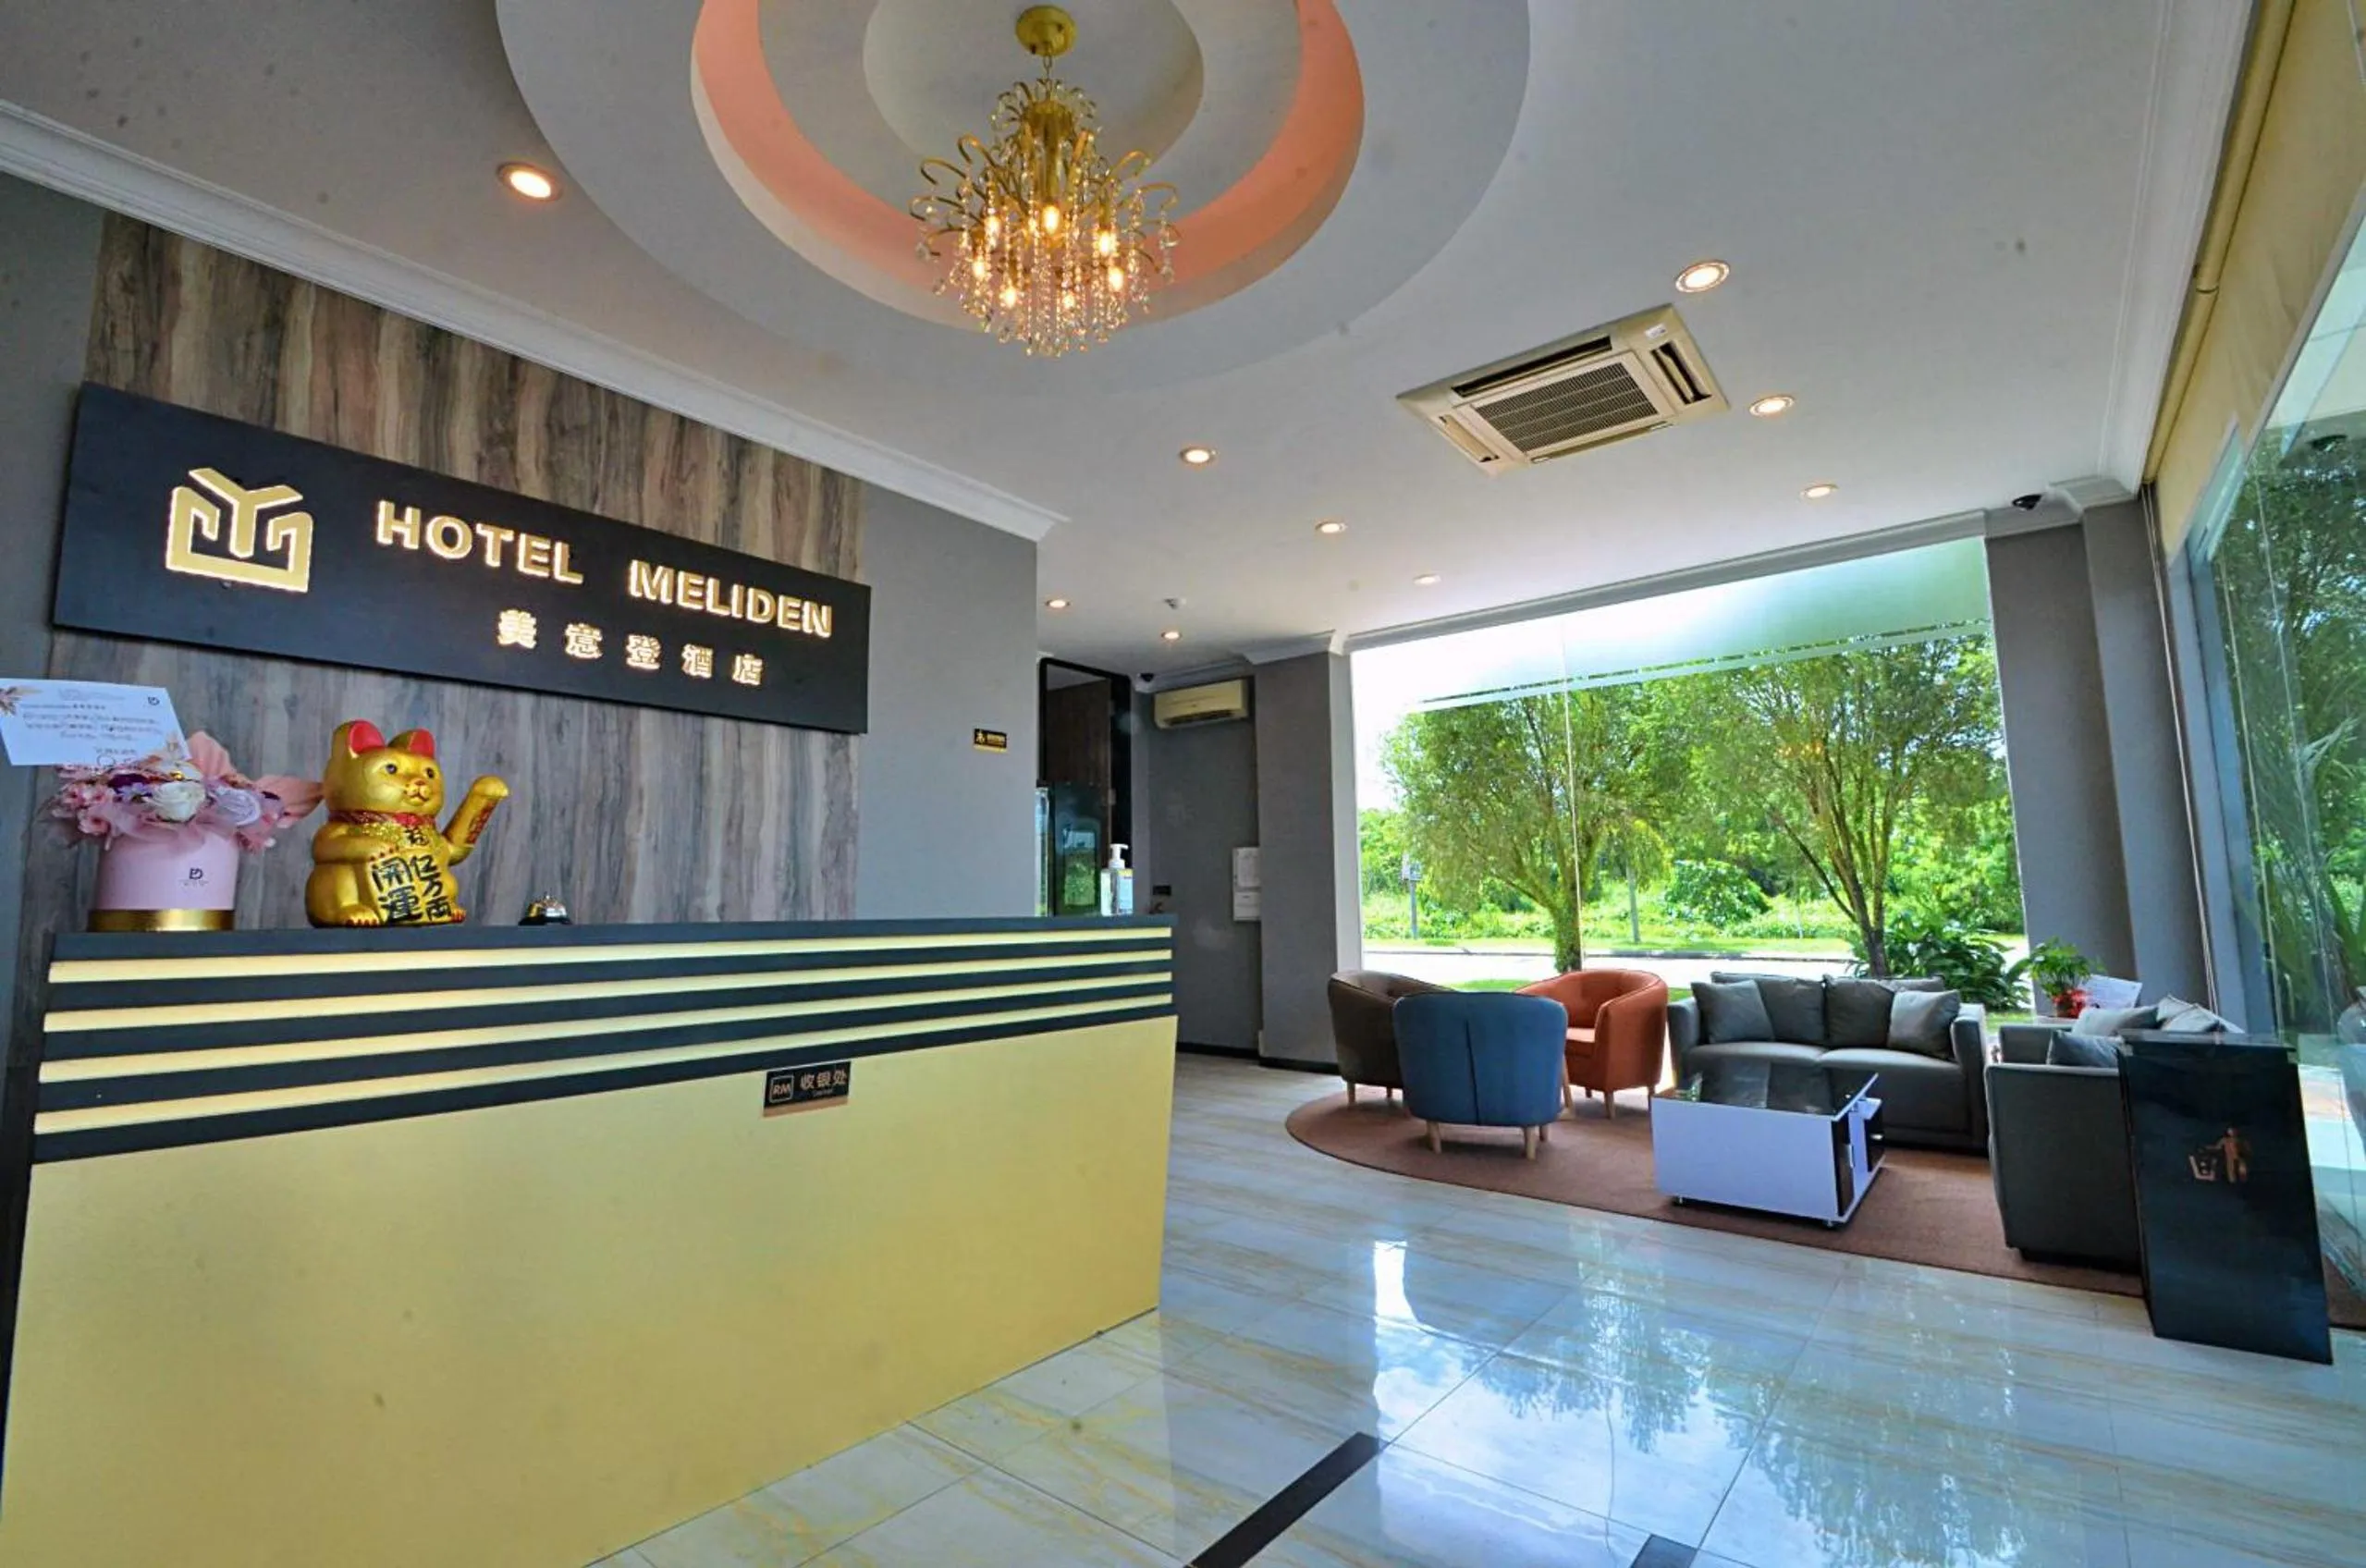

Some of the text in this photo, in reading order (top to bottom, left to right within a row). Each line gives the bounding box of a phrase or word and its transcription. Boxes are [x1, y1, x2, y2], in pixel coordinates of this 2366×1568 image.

[377, 499, 832, 638] HOTEL MELIDEN
[496, 609, 765, 686] 美意登酒店
